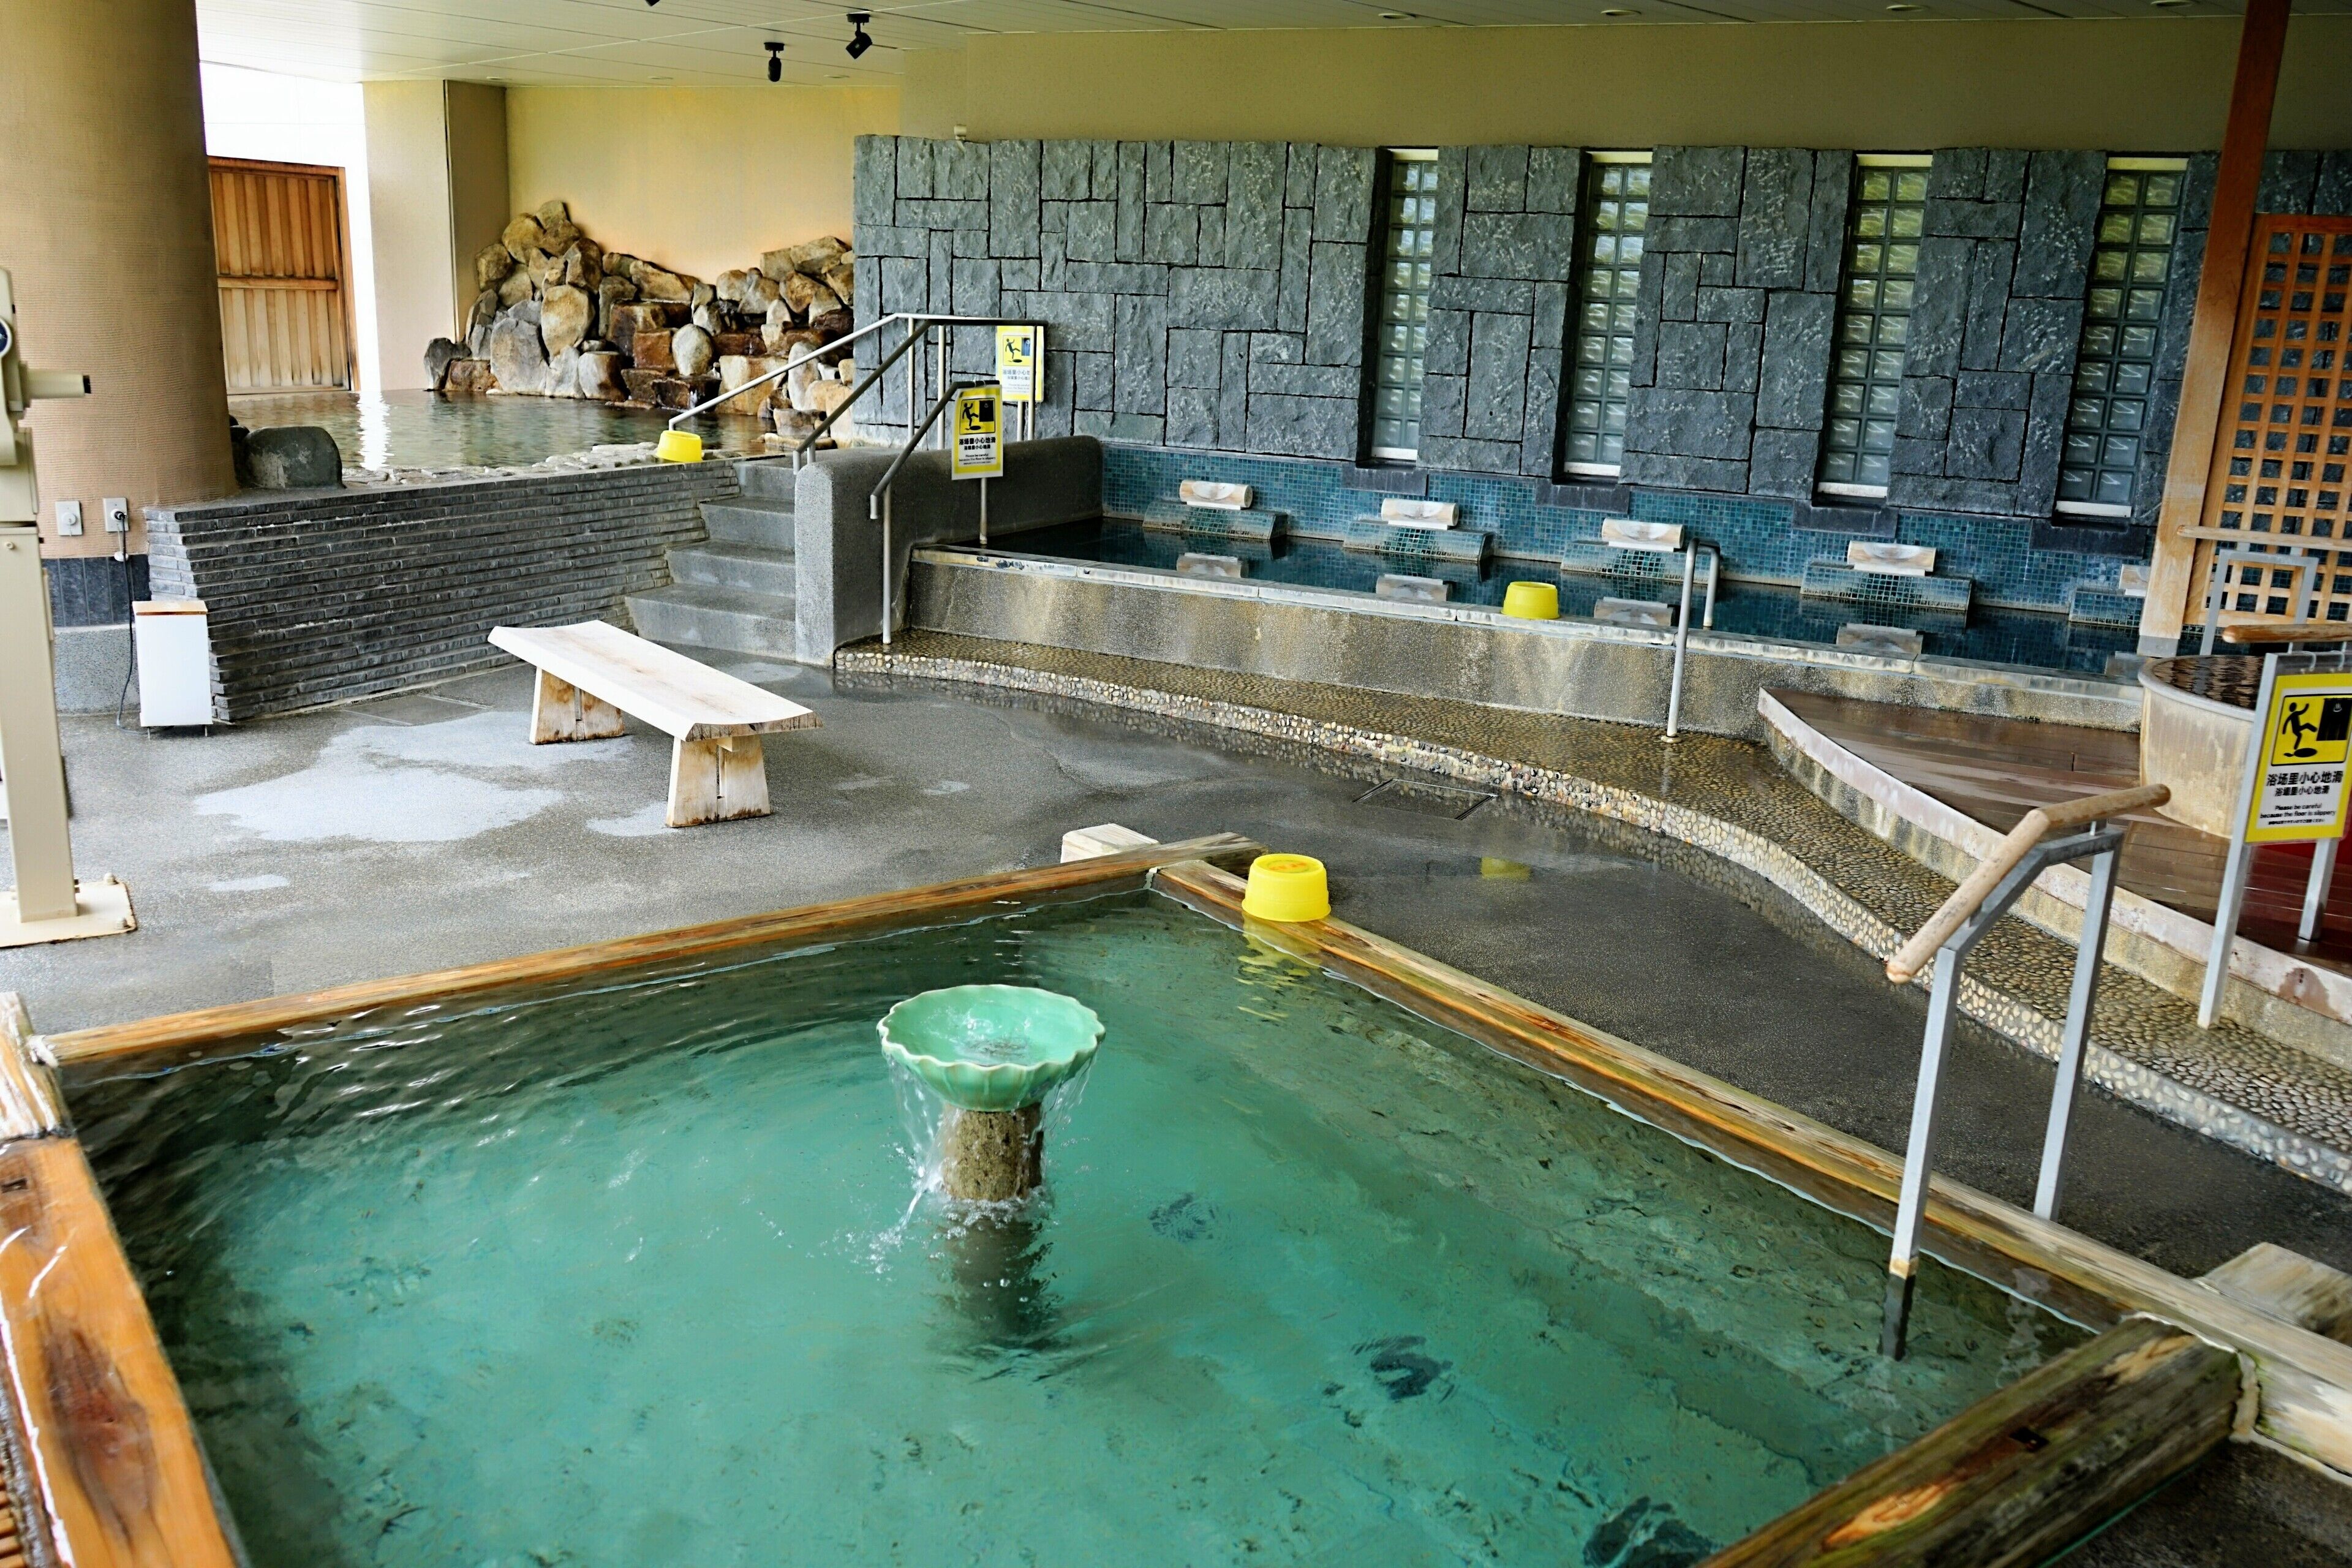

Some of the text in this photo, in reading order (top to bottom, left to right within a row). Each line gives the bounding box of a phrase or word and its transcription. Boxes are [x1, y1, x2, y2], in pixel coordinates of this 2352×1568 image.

[2266, 771, 2343, 786] 浴场里小心地滑
